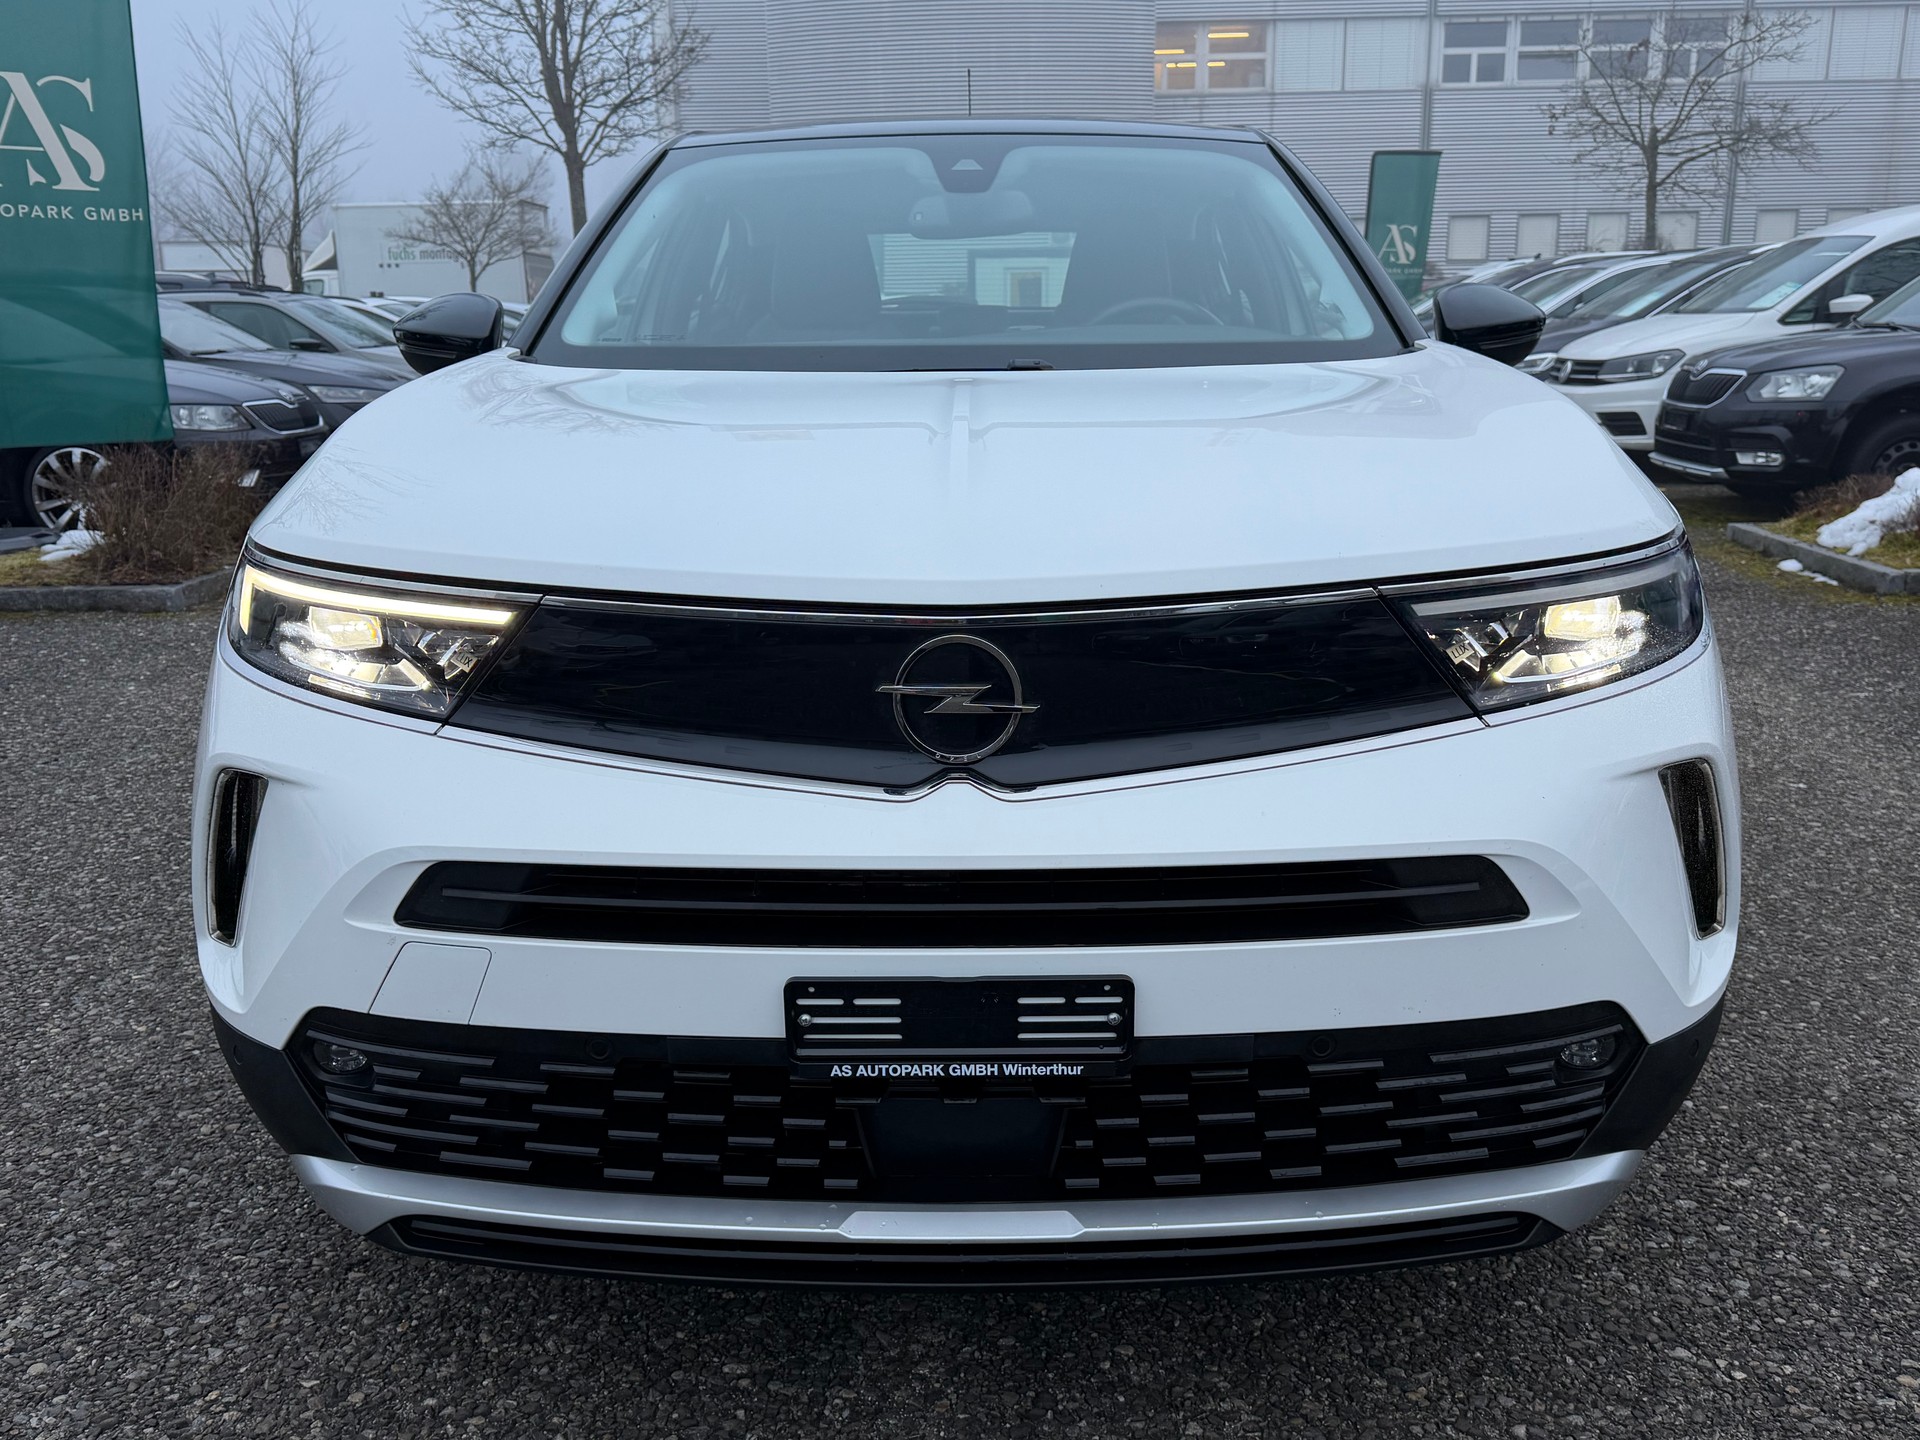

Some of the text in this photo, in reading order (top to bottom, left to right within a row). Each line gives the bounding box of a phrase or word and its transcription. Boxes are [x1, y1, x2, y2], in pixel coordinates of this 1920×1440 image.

[84, 207, 144, 222] GMBH
[1377, 224, 1418, 265] AS
[388, 247, 416, 261] fuchs
[1451, 644, 1470, 659] LUX
[830, 1063, 1084, 1077] AS AUTOPARK GMBH Winterthur
